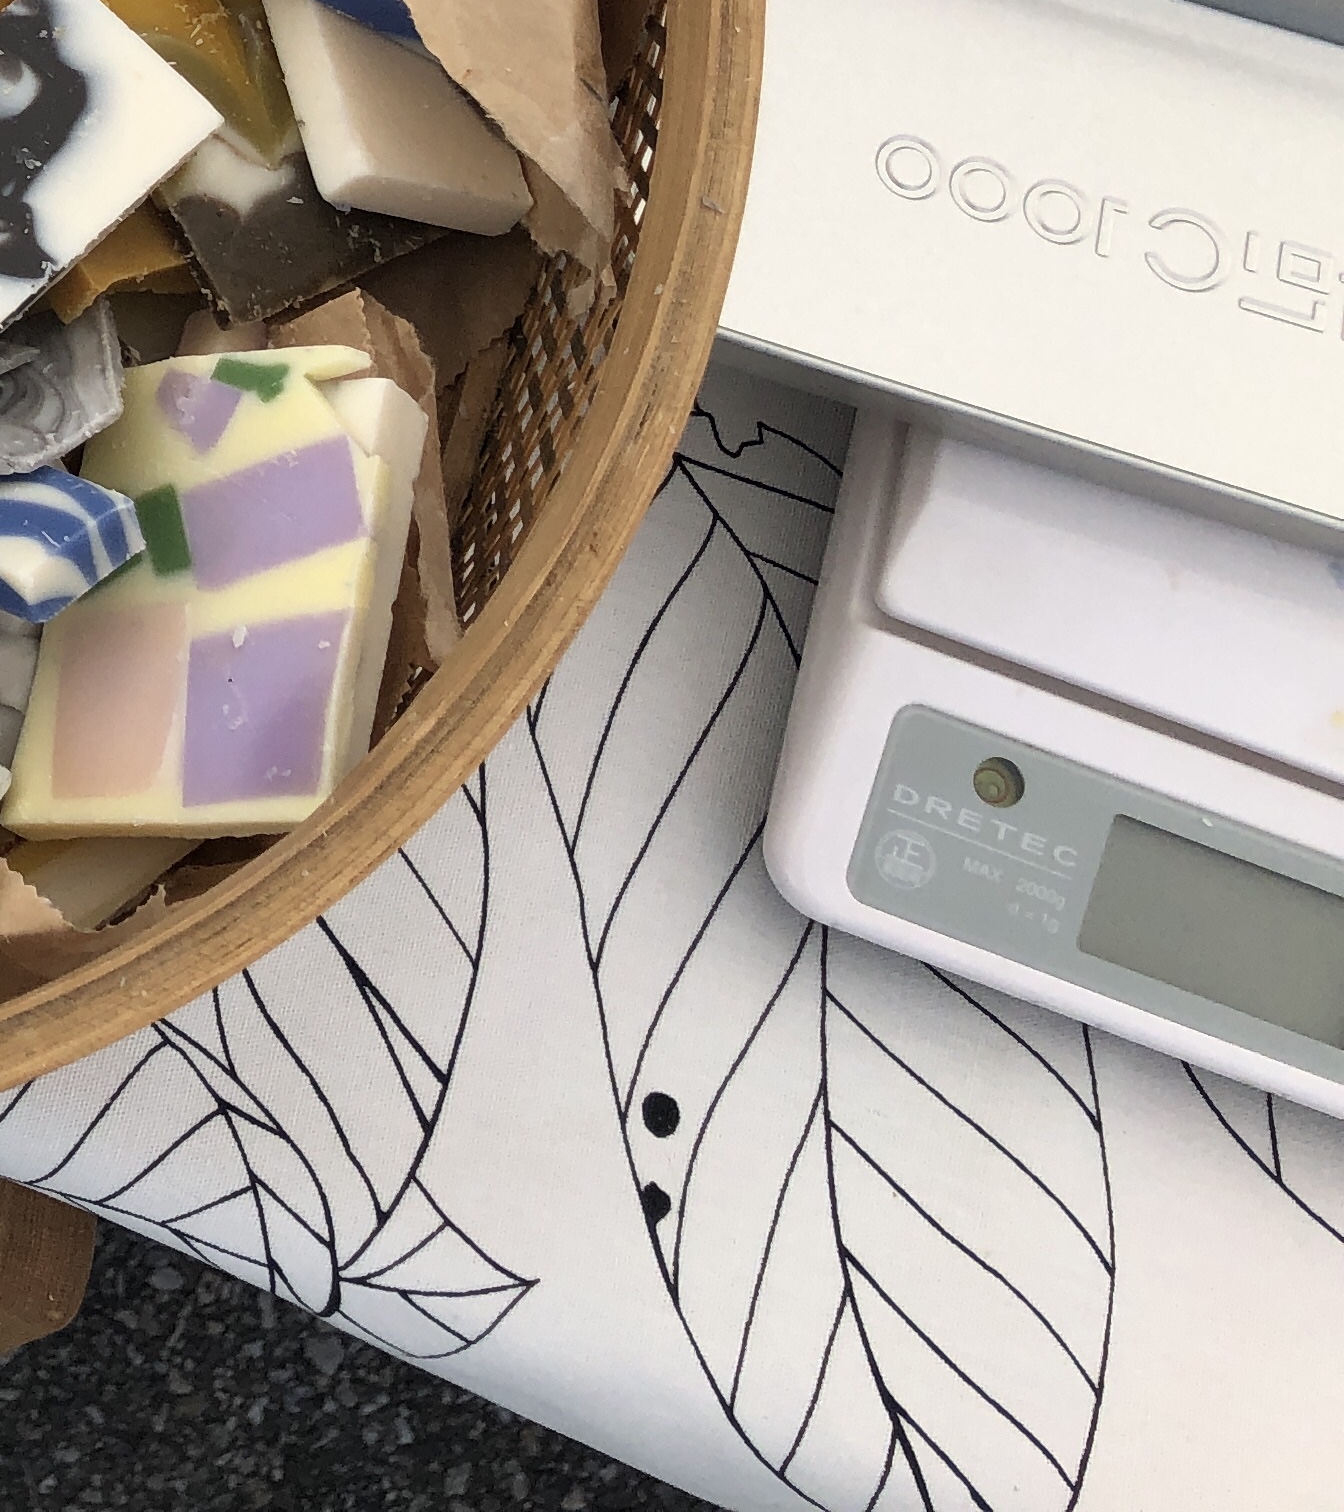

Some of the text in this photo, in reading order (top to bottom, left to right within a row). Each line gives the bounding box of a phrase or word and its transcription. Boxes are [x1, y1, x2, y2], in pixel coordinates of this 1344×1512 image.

[892, 784, 1078, 867] DRETEC
[963, 856, 1004, 883] MAX
[1015, 878, 1067, 911] 2000g
